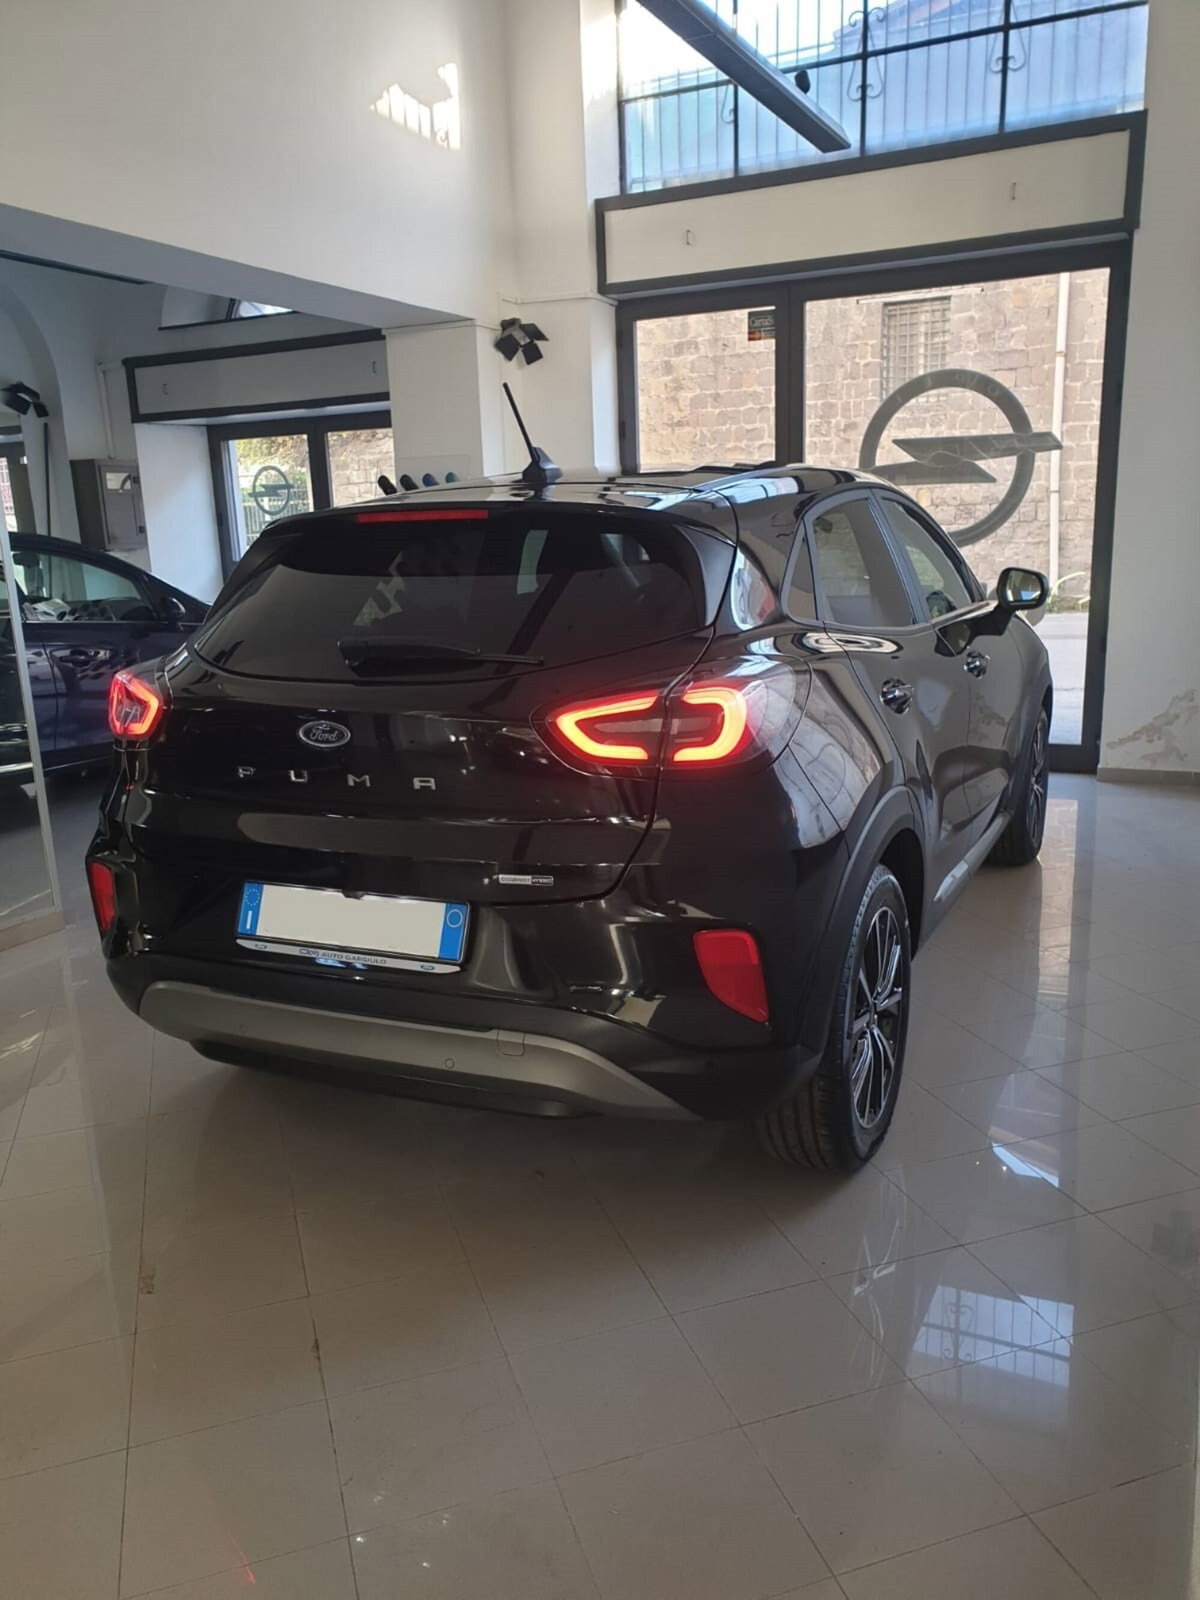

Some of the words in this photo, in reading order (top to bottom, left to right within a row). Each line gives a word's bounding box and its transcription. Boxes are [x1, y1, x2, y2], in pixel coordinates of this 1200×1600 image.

[310, 724, 338, 741] Ford
[237, 766, 436, 790] PUMA
[321, 952, 343, 960] AUTO
[345, 954, 387, 965] GARGIULO
